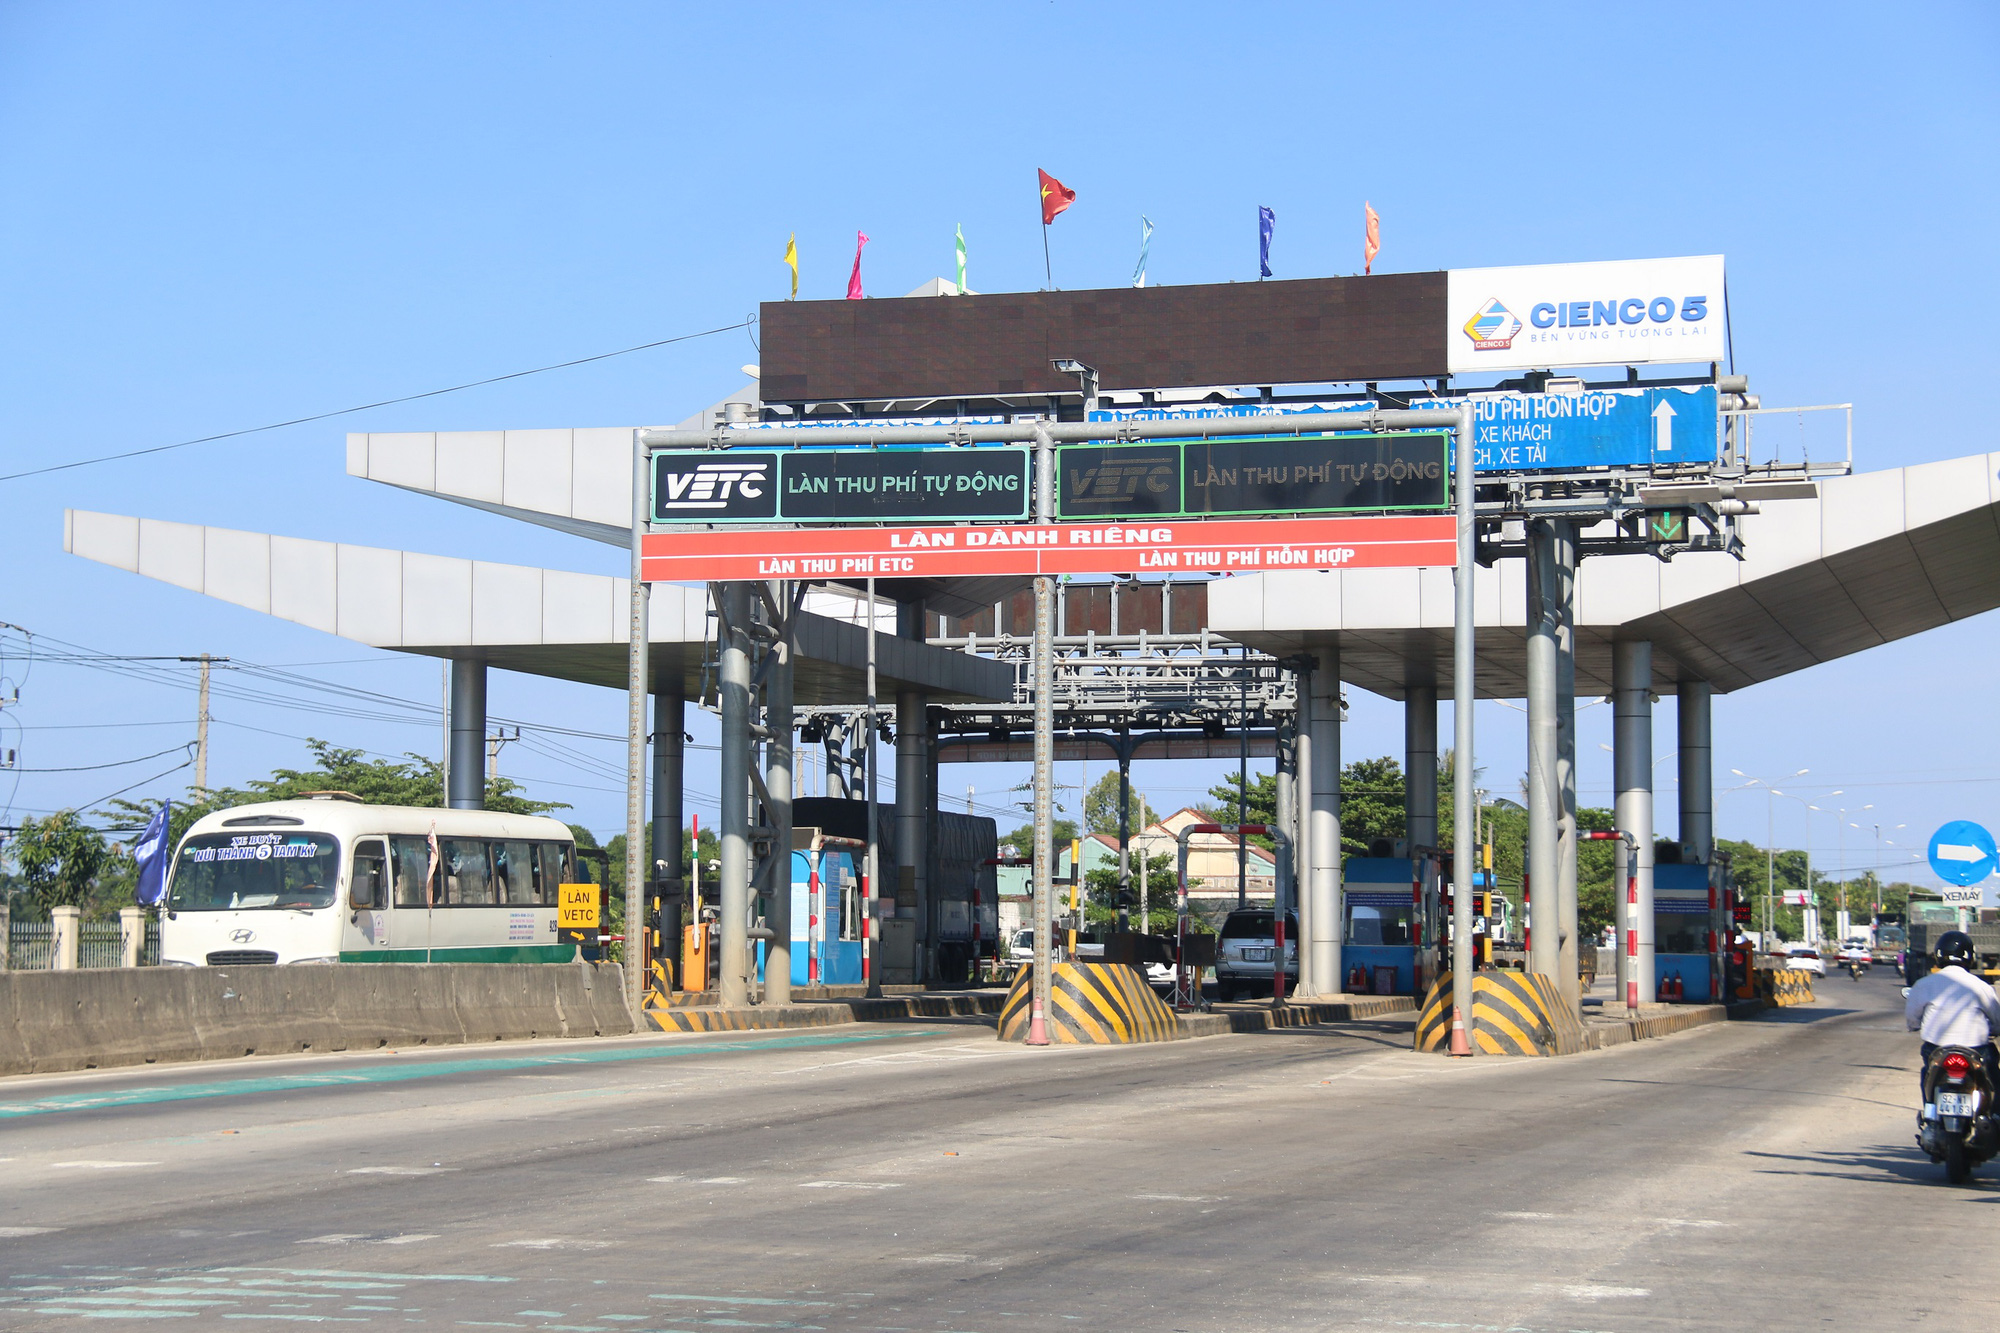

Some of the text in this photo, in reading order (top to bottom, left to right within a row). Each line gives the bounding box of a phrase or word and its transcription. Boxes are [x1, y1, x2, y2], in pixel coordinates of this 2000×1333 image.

[1530, 295, 1708, 328] CIENCO 5
[1681, 326, 1707, 336] LAI
[1475, 340, 1504, 348] CIENCO
[1577, 394, 1617, 420] HỢP
[1480, 426, 1499, 443] XE
[1502, 421, 1551, 442] KHÁCH
[1500, 447, 1520, 464] XE
[1525, 442, 1546, 463] TẢI
[666, 464, 768, 500] VETC
[788, 469, 1019, 497] LÀN THU PHÍ TỰ ĐỘNG
[1069, 457, 1174, 496] VETC
[1193, 458, 1441, 487] LÀN THU PHÍ TỰ ĐỘNG
[890, 526, 1173, 549] LÀN DÀNH RIÊNG
[758, 556, 914, 575] LÀN THU PHÍ ETC
[1139, 545, 1355, 568] LÀN THU PHÍ HỖN HỢP
[231, 836, 249, 846] XE
[194, 846, 216, 862] NÚI
[217, 845, 257, 861] THÀNH
[273, 845, 299, 857] TAM
[567, 889, 590, 904] LÀN
[563, 909, 594, 921] VETC
